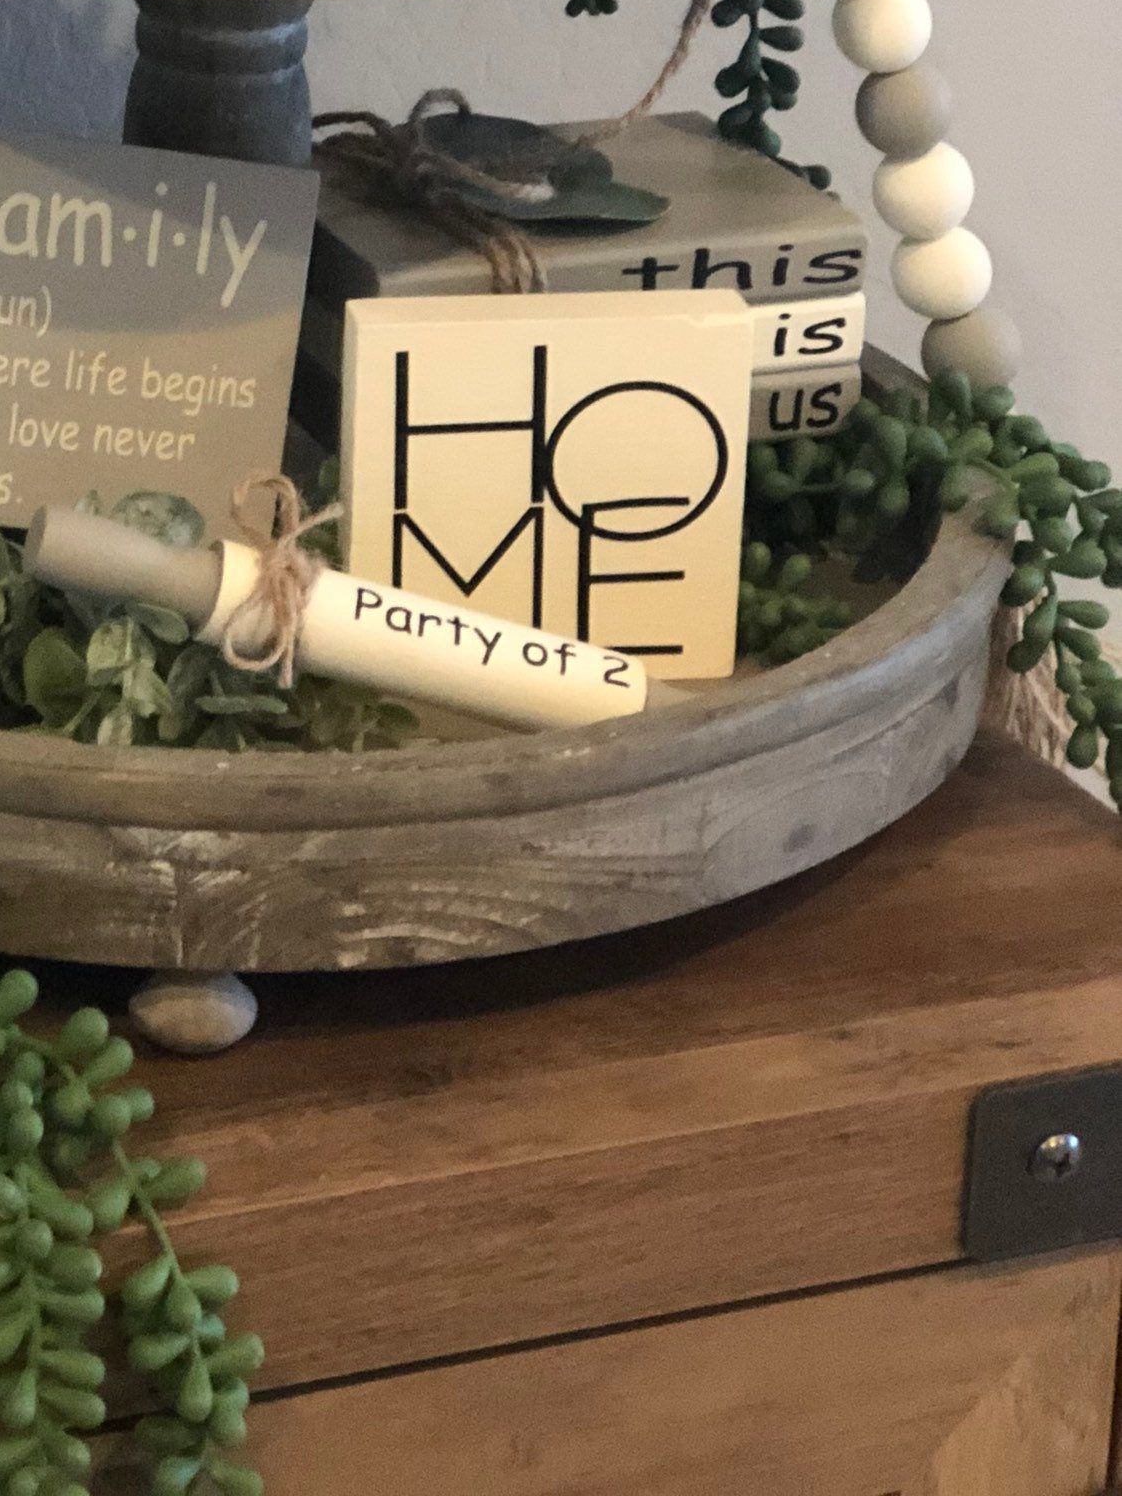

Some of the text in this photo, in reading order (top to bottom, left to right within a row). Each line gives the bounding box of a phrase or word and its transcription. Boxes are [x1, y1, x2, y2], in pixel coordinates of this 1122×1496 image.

[623, 244, 862, 291] this
[773, 313, 847, 357] is
[65, 350, 127, 396] life
[141, 357, 256, 416] begins
[768, 381, 842, 432] us
[9, 403, 79, 451] love
[93, 422, 196, 461] never
[354, 587, 631, 688] Party of 2
